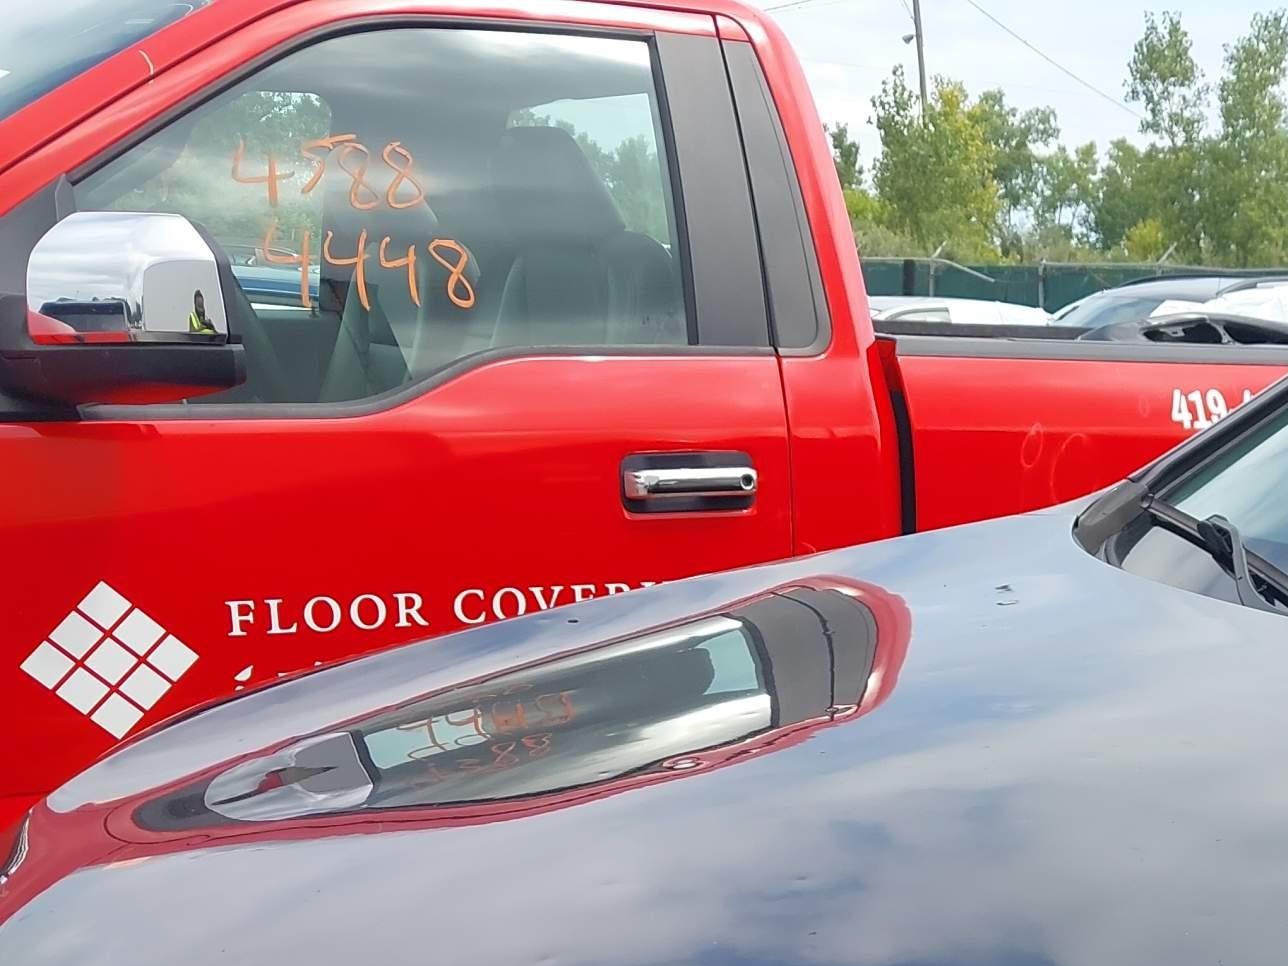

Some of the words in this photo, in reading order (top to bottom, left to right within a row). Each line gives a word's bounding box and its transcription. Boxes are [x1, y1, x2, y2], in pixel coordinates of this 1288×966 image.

[231, 133, 425, 210] 4588
[262, 215, 476, 311] 4448
[225, 592, 430, 637] FLOOR
